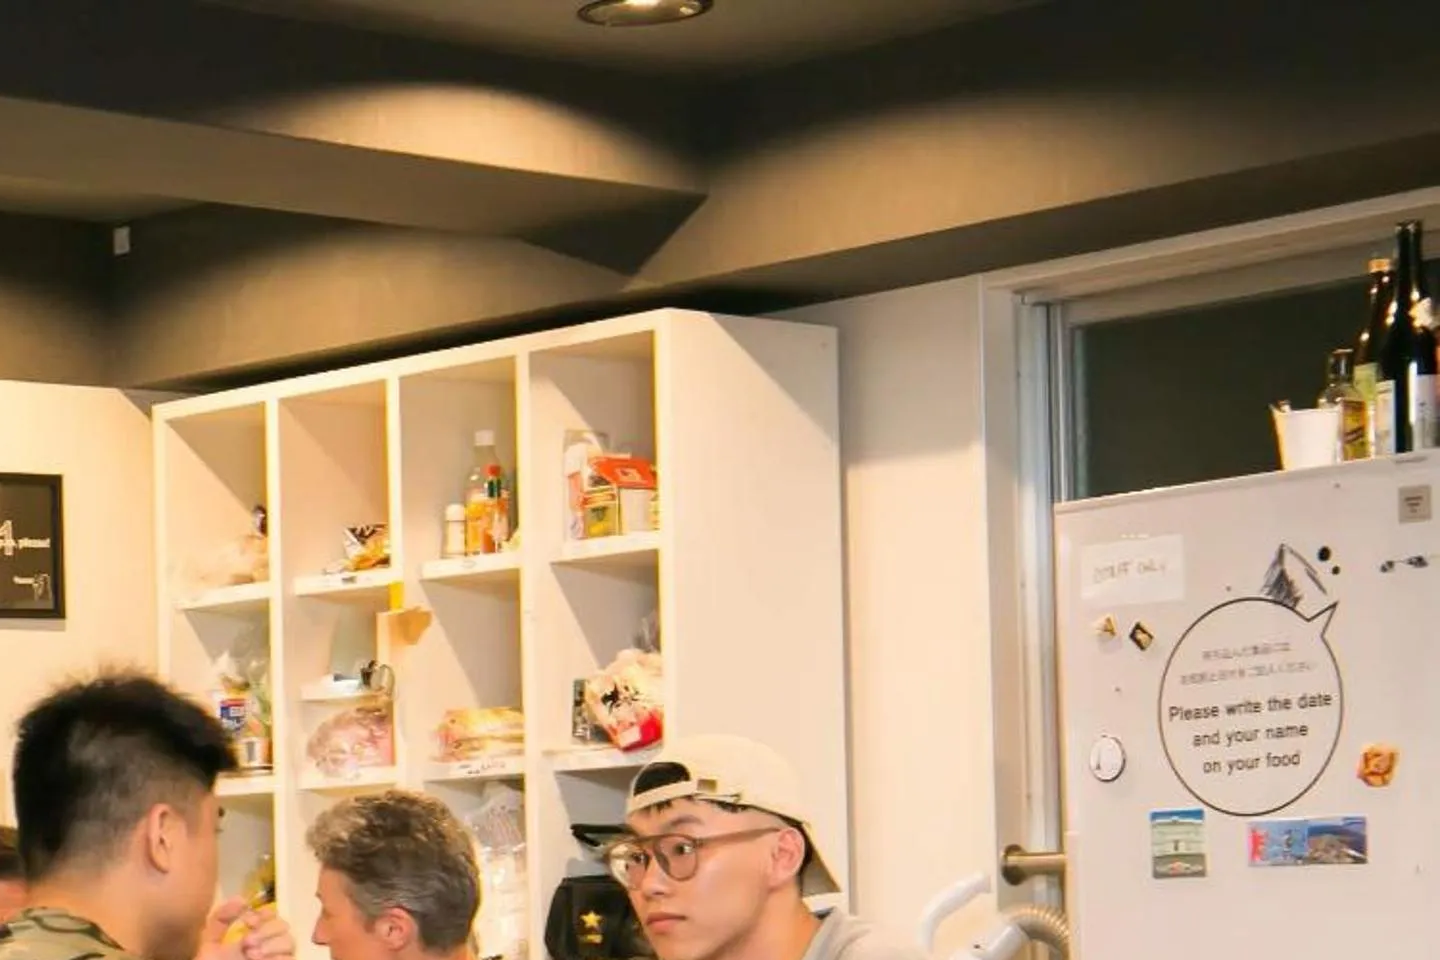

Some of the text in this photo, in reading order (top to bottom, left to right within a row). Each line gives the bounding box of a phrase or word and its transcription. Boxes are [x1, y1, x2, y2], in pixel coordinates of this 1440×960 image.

[1168, 692, 1333, 722] Please write the date
[1192, 722, 1309, 748] and your name
[1202, 750, 1301, 776] on your food
